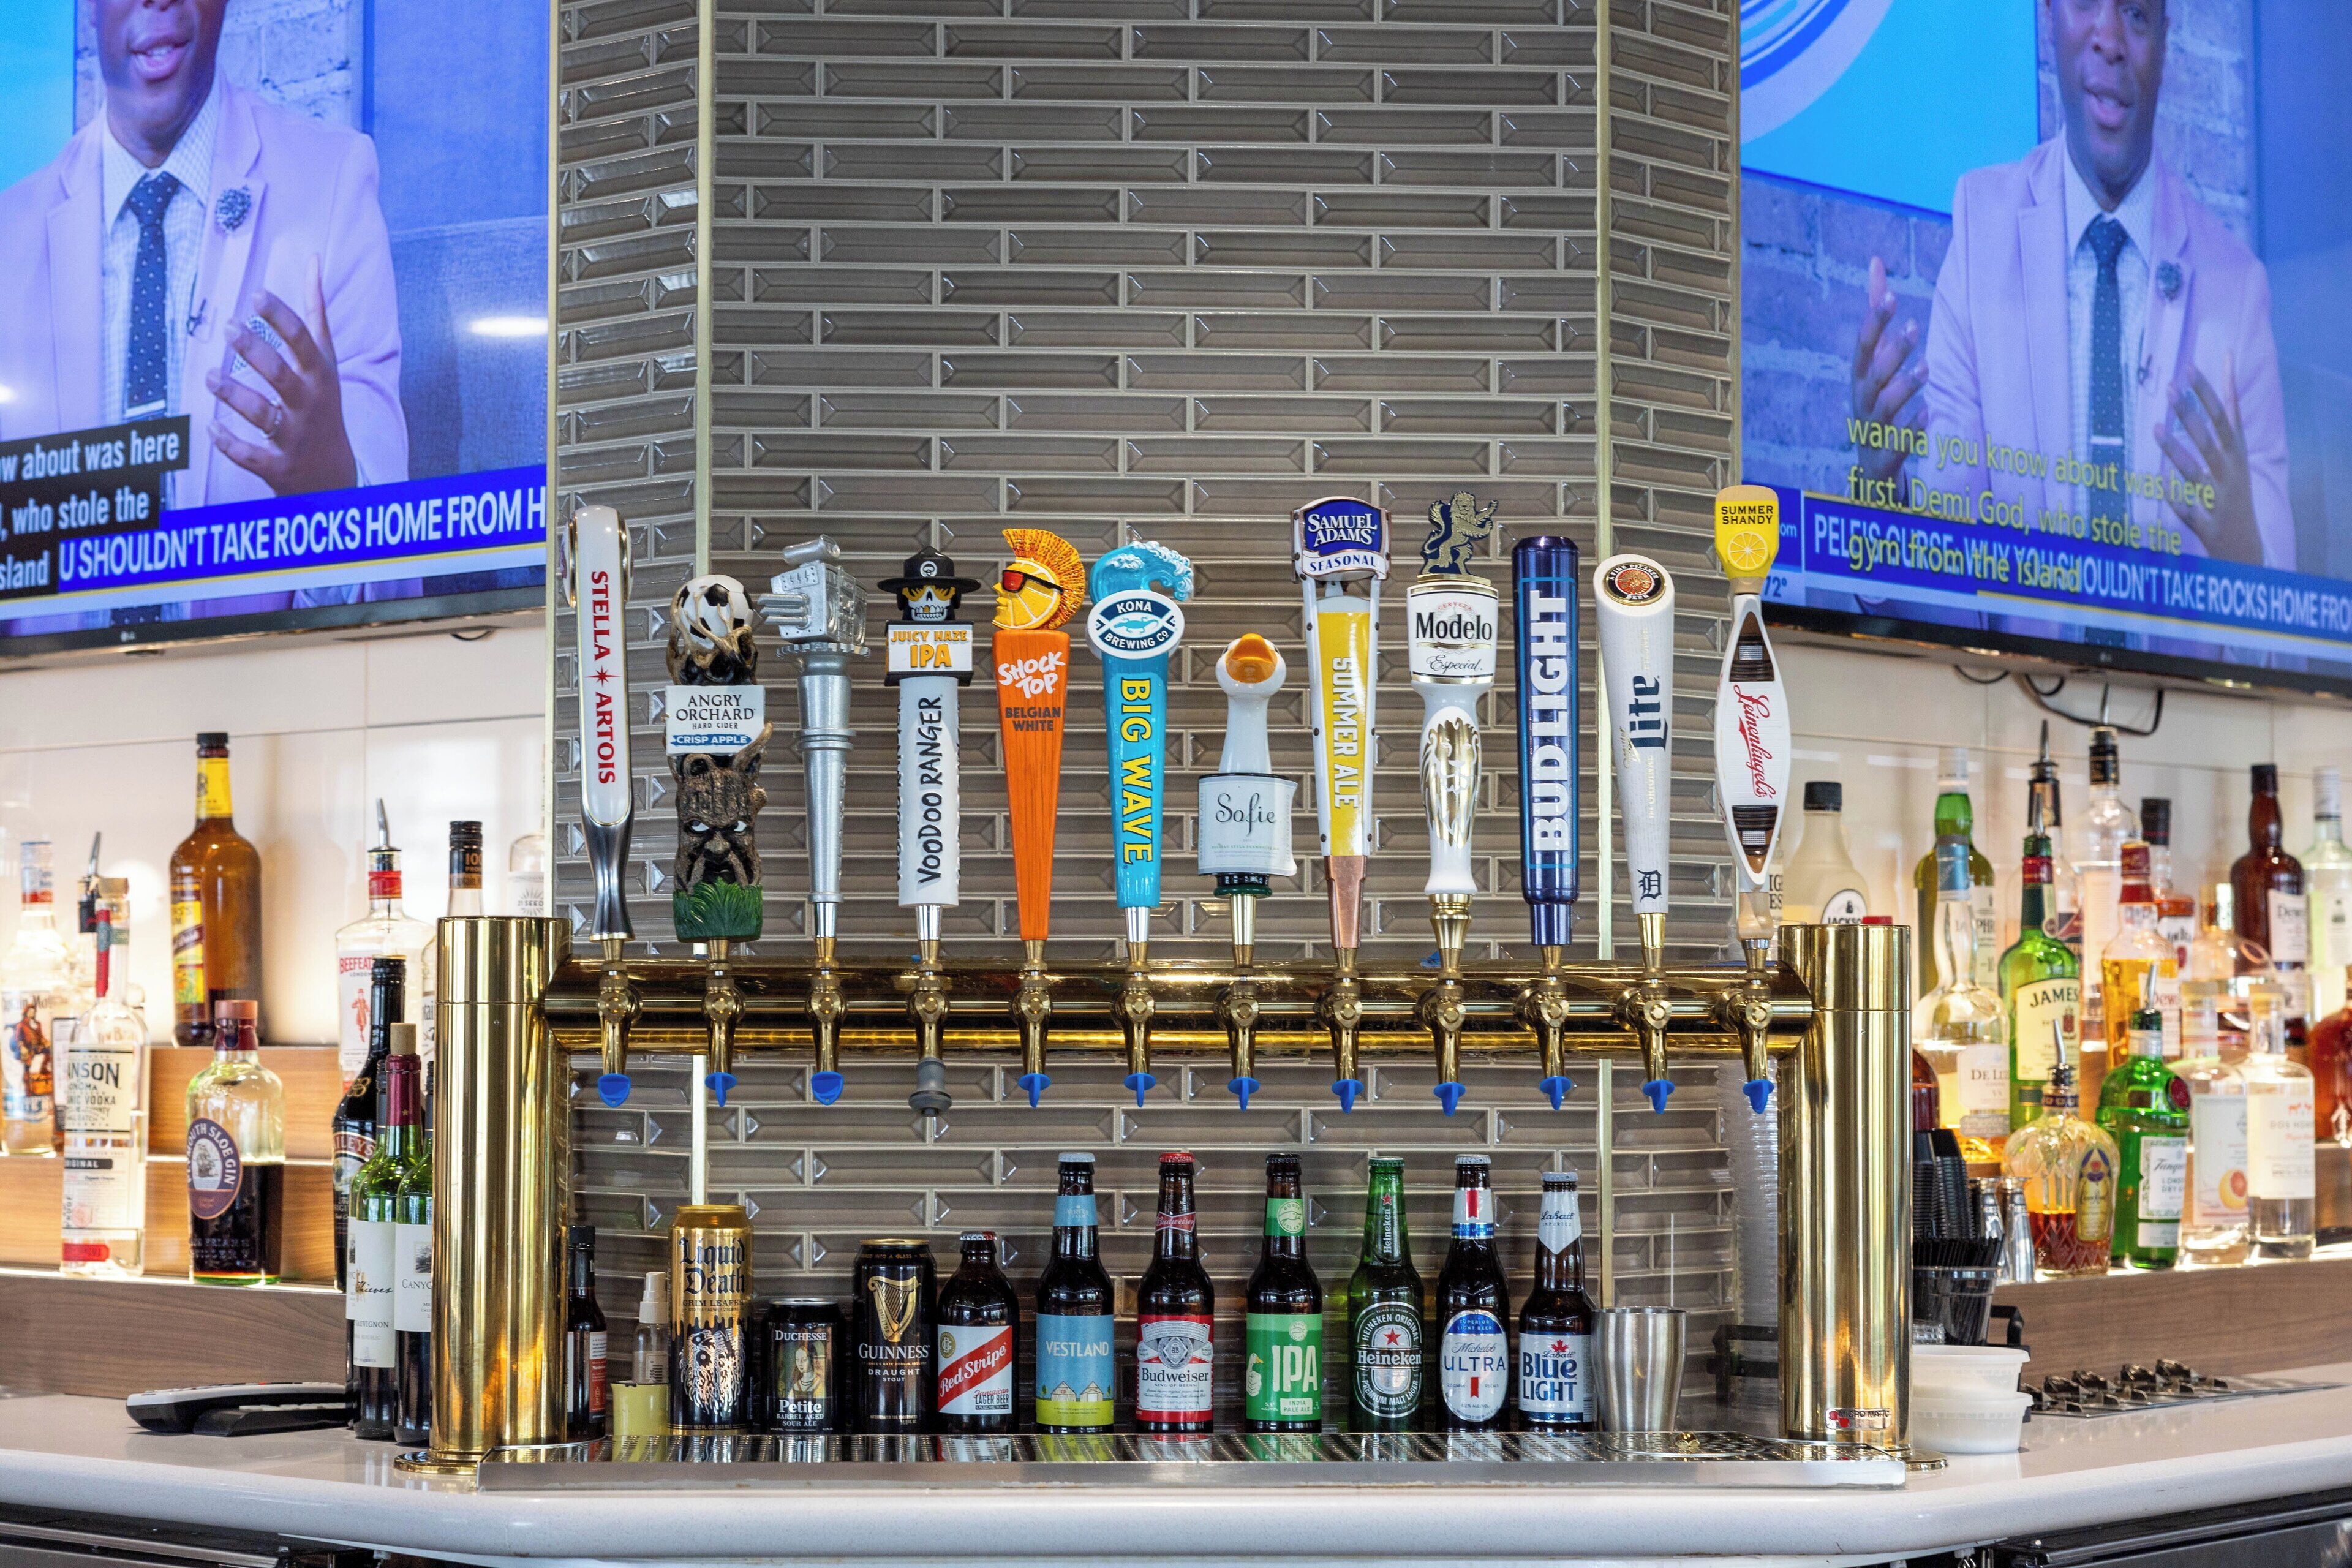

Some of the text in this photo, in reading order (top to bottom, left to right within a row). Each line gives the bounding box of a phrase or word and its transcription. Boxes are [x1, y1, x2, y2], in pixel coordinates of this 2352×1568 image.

[21, 439, 81, 480] about
[85, 440, 126, 472] was
[130, 429, 179, 466] here
[1847, 418, 2215, 509] wanna you know about was here
[12, 485, 149, 535] who stole the
[1308, 513, 1378, 532] SAMUEL
[1721, 505, 1774, 514] SUMMER
[1722, 515, 1773, 524] SHANDY
[1910, 478, 1970, 519] Demi
[2038, 499, 2084, 540] who
[2092, 513, 2141, 549] stole
[2148, 519, 2182, 556] the
[78, 526, 208, 579] SHOULDN'T
[211, 518, 269, 565] TAKE
[274, 506, 361, 557] ROCKS
[366, 497, 442, 548] HOME
[447, 488, 522, 539] FROM
[1313, 528, 1373, 547] ADAMS
[1310, 554, 1378, 572] SEASONAL
[1849, 533, 2010, 583] gym from the
[1116, 600, 1153, 613] KONA
[2162, 570, 2205, 611] TAKE
[2208, 576, 2266, 620] ROCKS
[2270, 585, 2317, 627] HOME
[891, 630, 967, 642] JUICY HAZE
[1415, 612, 1493, 640] Modelo
[1104, 632, 1156, 649] BREWING
[910, 644, 952, 668] IPA
[998, 651, 1066, 686] SHOCK
[592, 571, 616, 785] STELLA ARTOIS
[1016, 673, 1058, 699] TOP
[688, 695, 742, 707] ANGRY
[1005, 707, 1061, 718] BELGIAN
[1629, 676, 1668, 752] Lite
[676, 708, 754, 721] ORCHARD
[1012, 720, 1054, 731] WHITE
[1529, 590, 1568, 851] BUD LIGHT
[1332, 657, 1359, 809] SUMMER ALE
[1121, 679, 1152, 865] BIG WAVE
[1646, 755, 1656, 807] ORIGINAL
[916, 697, 942, 884] VOODOO RANGER
[1215, 793, 1275, 837] Sofie
[209, 1126, 236, 1186] SLOE GIN
[1156, 1215, 1196, 1226] Budweiser
[1540, 1210, 1575, 1220] Labatt
[1382, 1208, 1391, 1254] Heineken
[679, 1237, 745, 1273] Liquid
[684, 1265, 745, 1295] Death
[775, 1330, 827, 1341] DUCHESSE
[1362, 1313, 1419, 1342] HEINEKEN ORIGINAL
[859, 1343, 929, 1359] GUINNESS
[1046, 1341, 1109, 1357] VESTLAND
[1357, 1349, 1422, 1366] Heineken
[1452, 1342, 1497, 1354] Michelob
[1542, 1349, 1574, 1359] Labatt
[940, 1345, 1007, 1397] Red Stripe
[1142, 1367, 1209, 1382] Budweiser
[1272, 1344, 1318, 1393] IPA
[1444, 1355, 1506, 1372] ULTRA
[1523, 1352, 1577, 1379] Blue
[975, 1394, 1009, 1404] LAGER BEER
[1362, 1379, 1419, 1406] PREMIUM MALT LAGER
[1523, 1379, 1577, 1401] LIGHT
[778, 1399, 823, 1414] Petite
